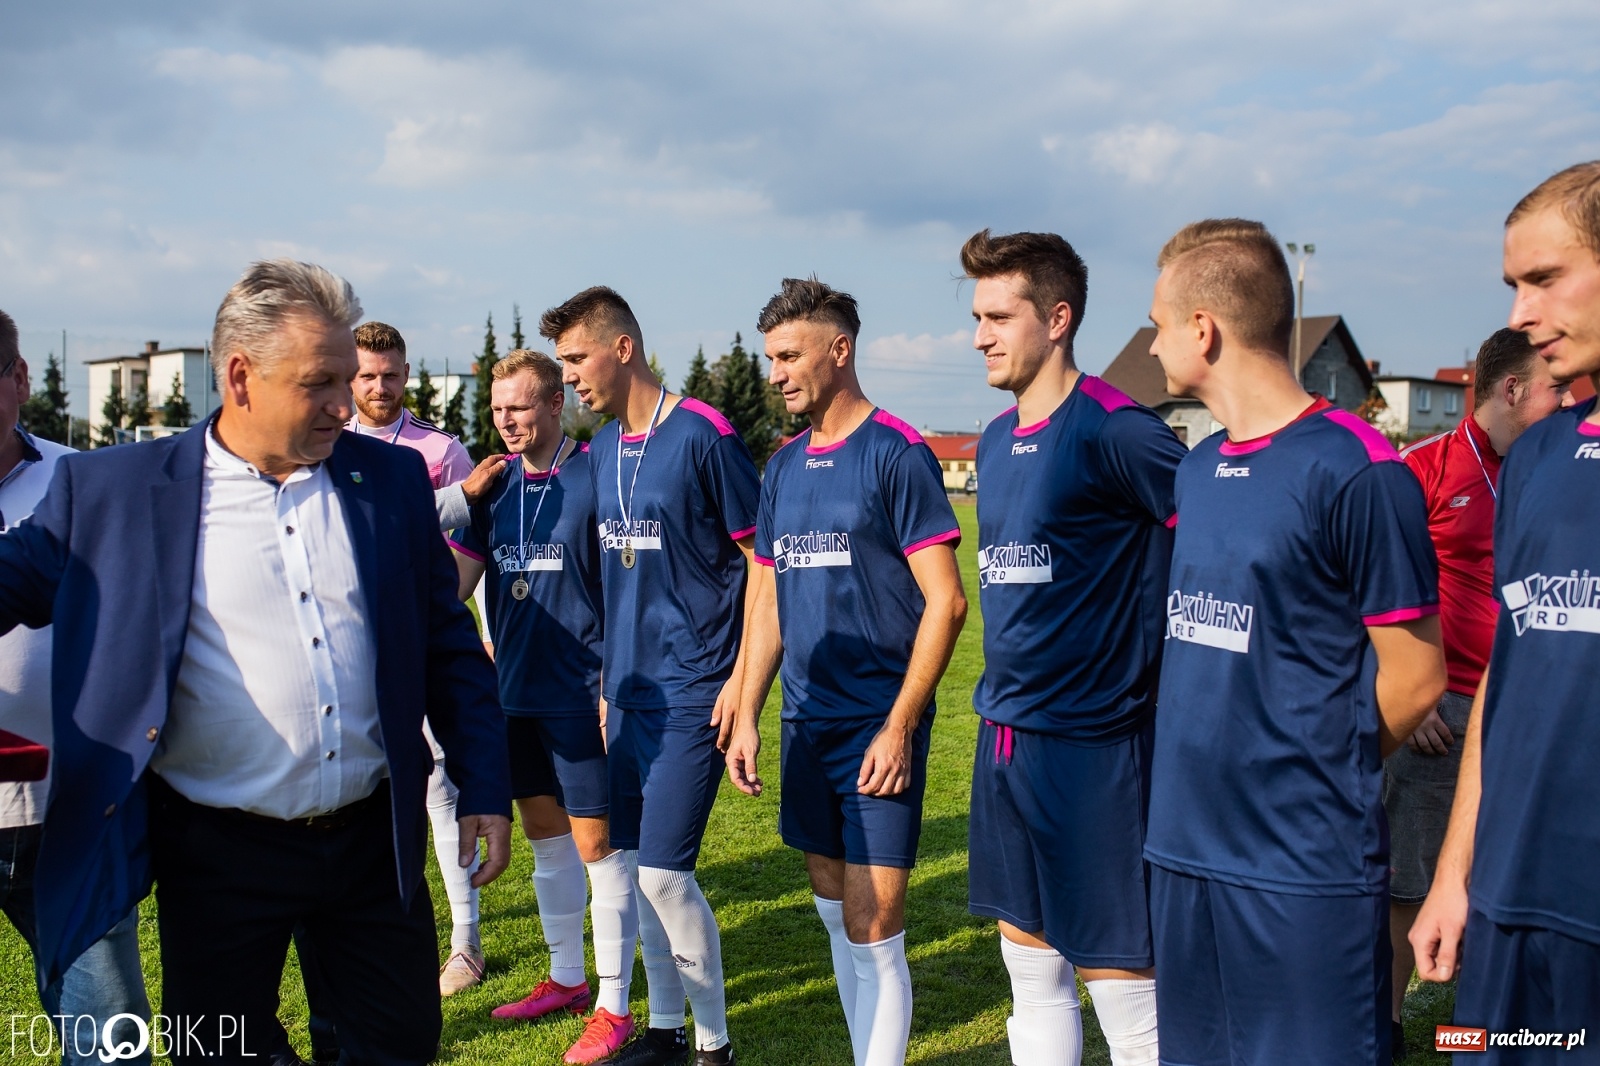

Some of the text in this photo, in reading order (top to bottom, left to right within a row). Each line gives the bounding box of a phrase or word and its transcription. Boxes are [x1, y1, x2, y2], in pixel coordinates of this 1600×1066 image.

[791, 530, 849, 555] KÜHN
[993, 541, 1051, 568] KÜHN
[789, 556, 811, 565] RD
[989, 570, 1006, 581] RD
[1182, 591, 1253, 633] KÜHN
